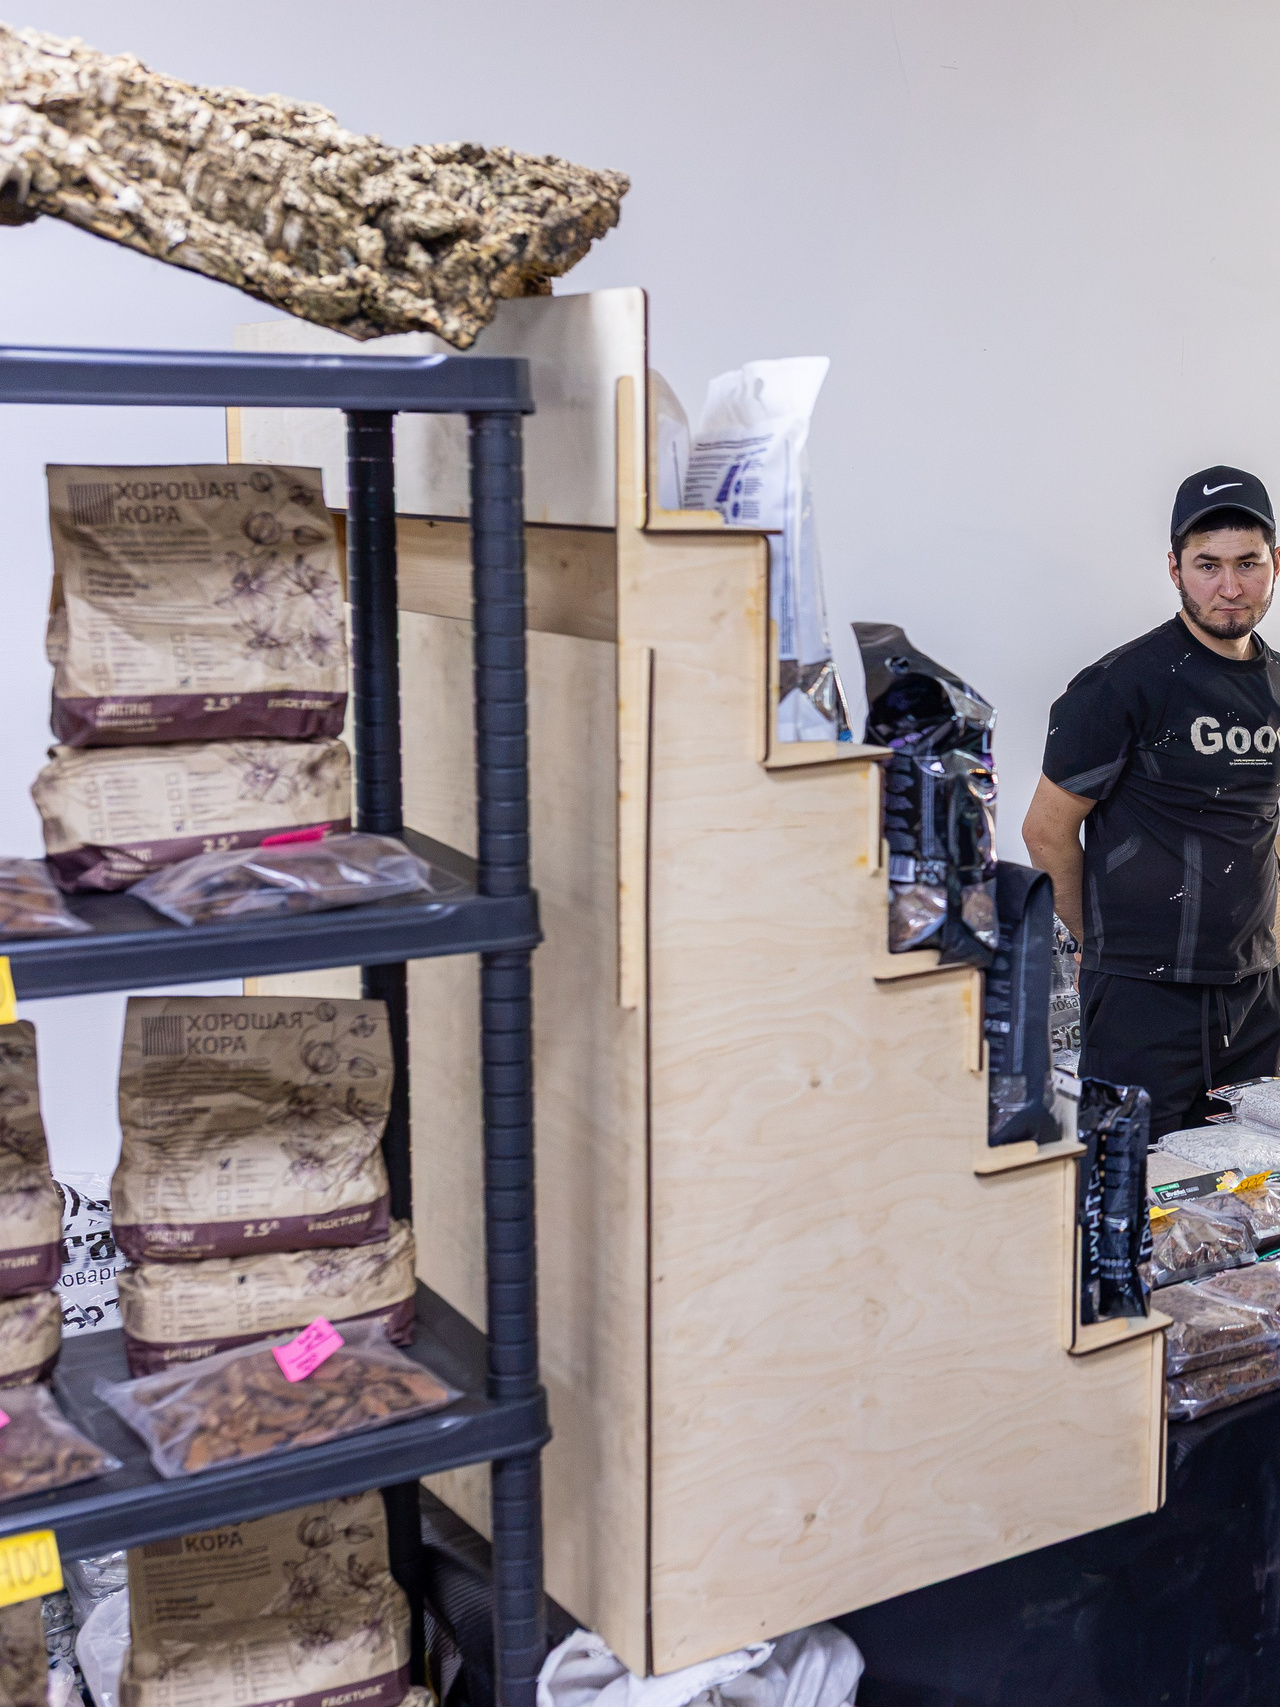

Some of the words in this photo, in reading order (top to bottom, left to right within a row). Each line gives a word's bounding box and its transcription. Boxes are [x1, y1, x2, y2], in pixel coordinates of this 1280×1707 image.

[113, 481, 239, 501] ХОРОШАЯ
[116, 504, 182, 524] КОРА
[186, 1011, 305, 1032] ХОРОШАЯ
[186, 1035, 248, 1055] КОРА
[185, 1531, 244, 1554] КОРА
